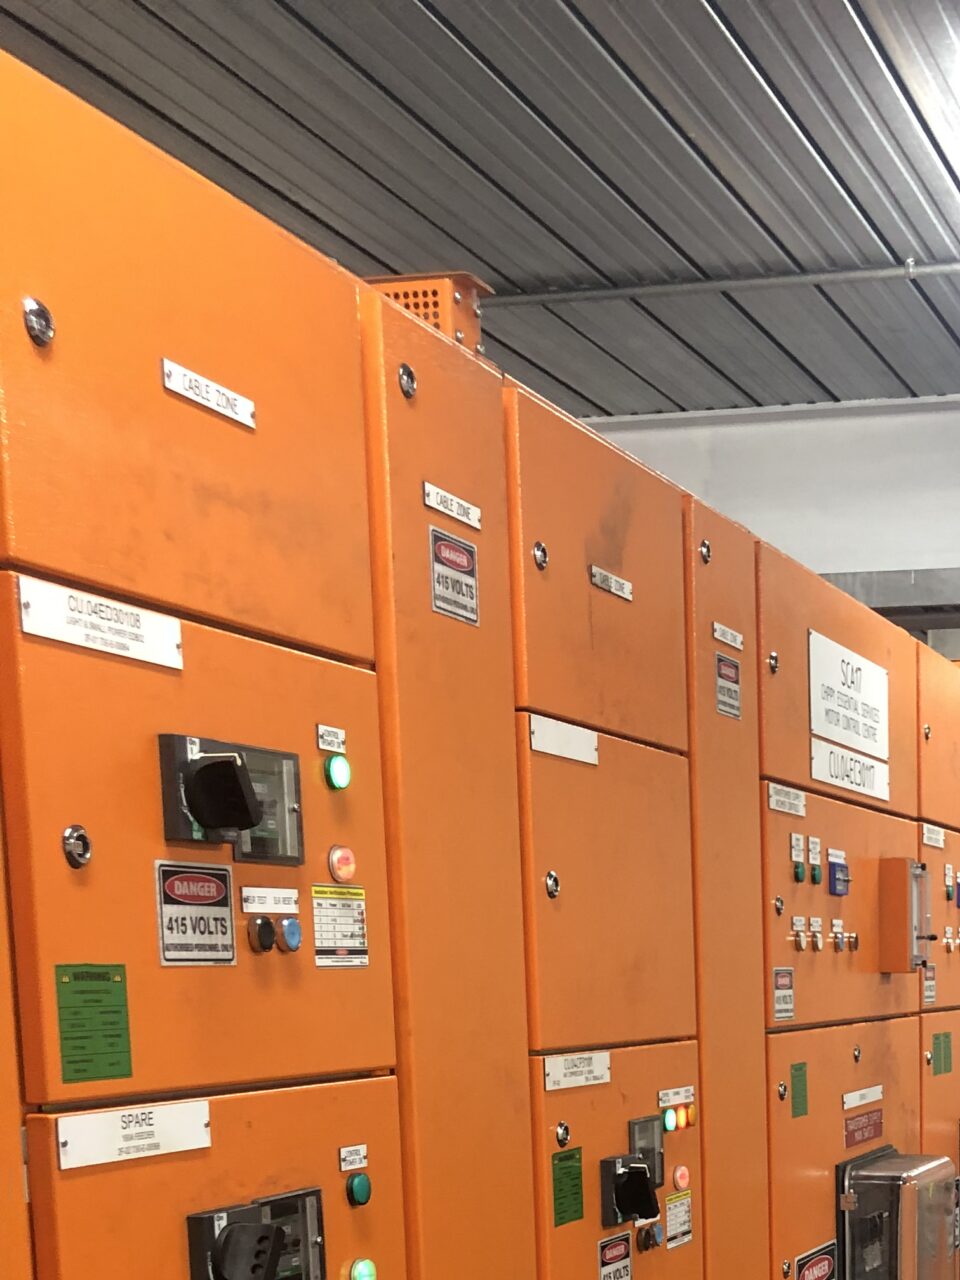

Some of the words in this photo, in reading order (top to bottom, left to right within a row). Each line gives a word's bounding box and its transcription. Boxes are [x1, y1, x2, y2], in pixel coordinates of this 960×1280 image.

[183, 373, 210, 402] CABLE
[216, 389, 239, 415] ZONE
[436, 492, 454, 512] CABLE
[456, 501, 472, 520] ZONE
[440, 545, 468, 567] DANGER
[436, 573, 450, 590] 415
[451, 579, 475, 600] VOLTS
[174, 880, 216, 896] DANGER
[166, 915, 187, 934] 415
[190, 916, 227, 935] VOLTS
[121, 1111, 154, 1130] SPARE
[612, 1265, 629, 1280] VOLTS
